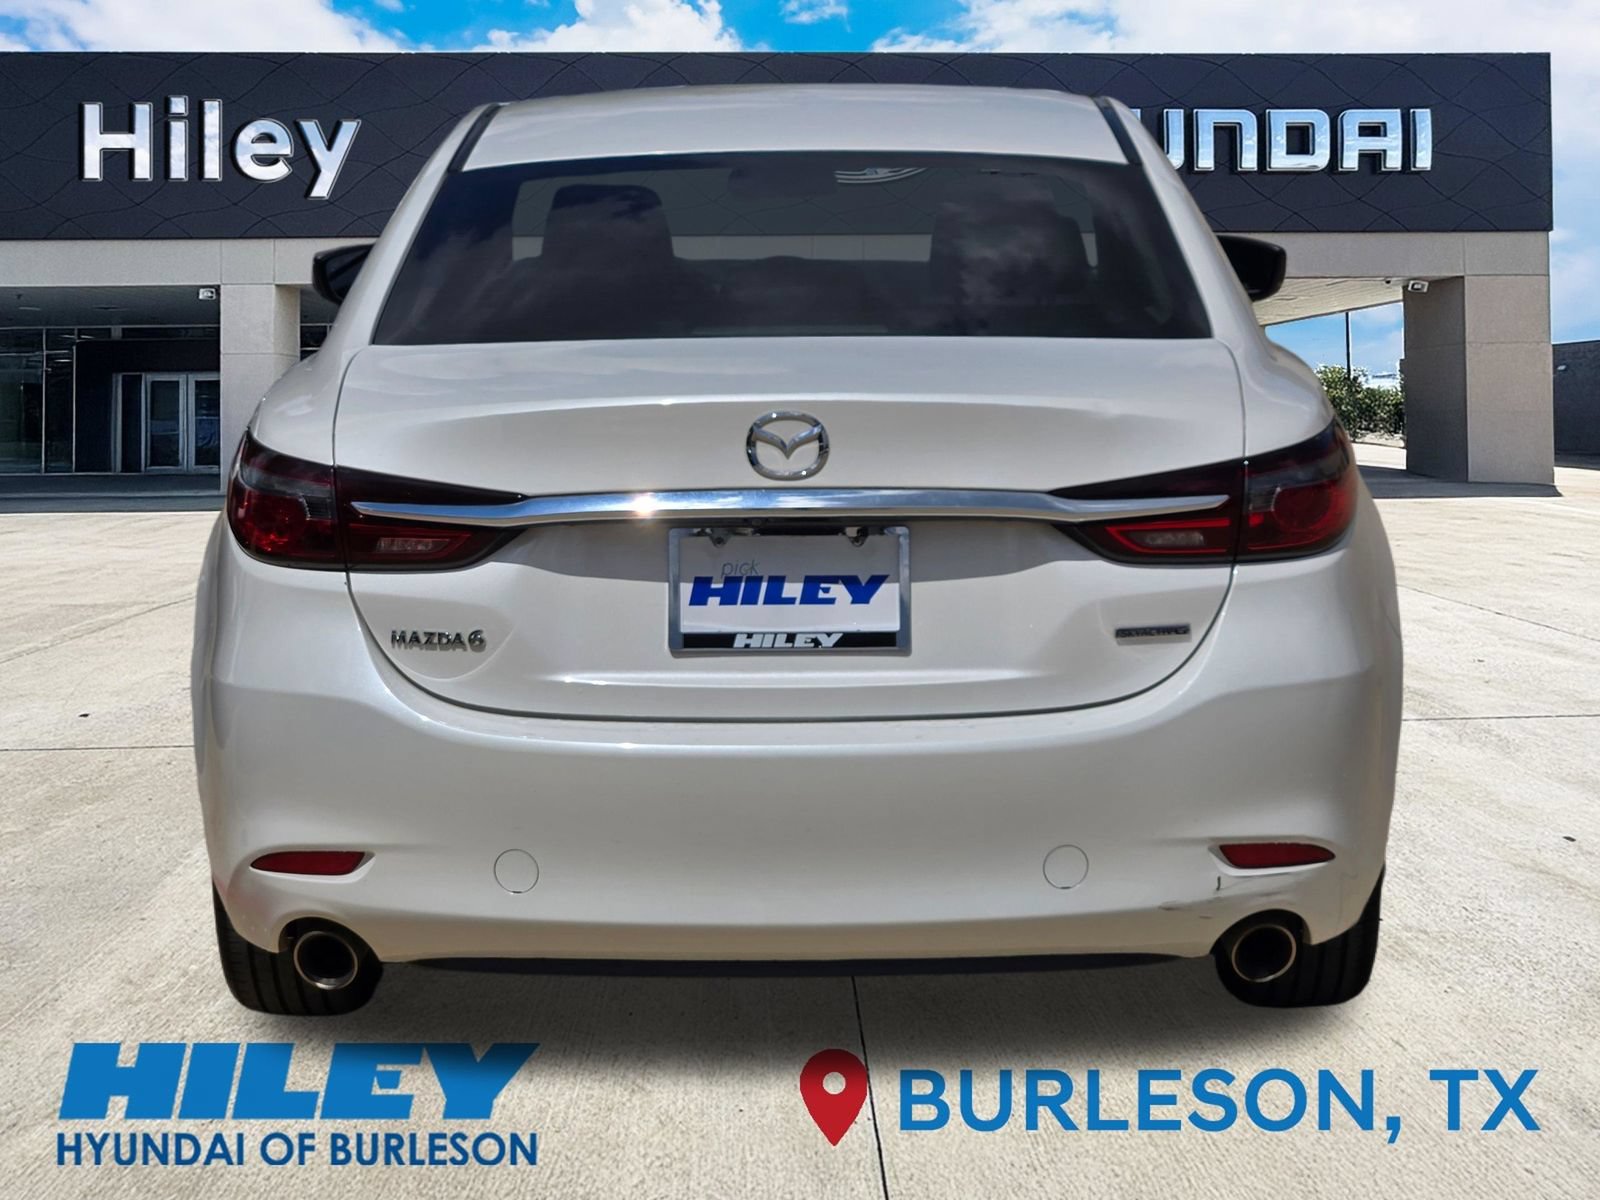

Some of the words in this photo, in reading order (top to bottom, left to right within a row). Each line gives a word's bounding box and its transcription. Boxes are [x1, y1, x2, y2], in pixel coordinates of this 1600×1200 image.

[80, 95, 362, 199] Hiley
[688, 575, 890, 606] HILEY
[733, 632, 843, 648] HILEY
